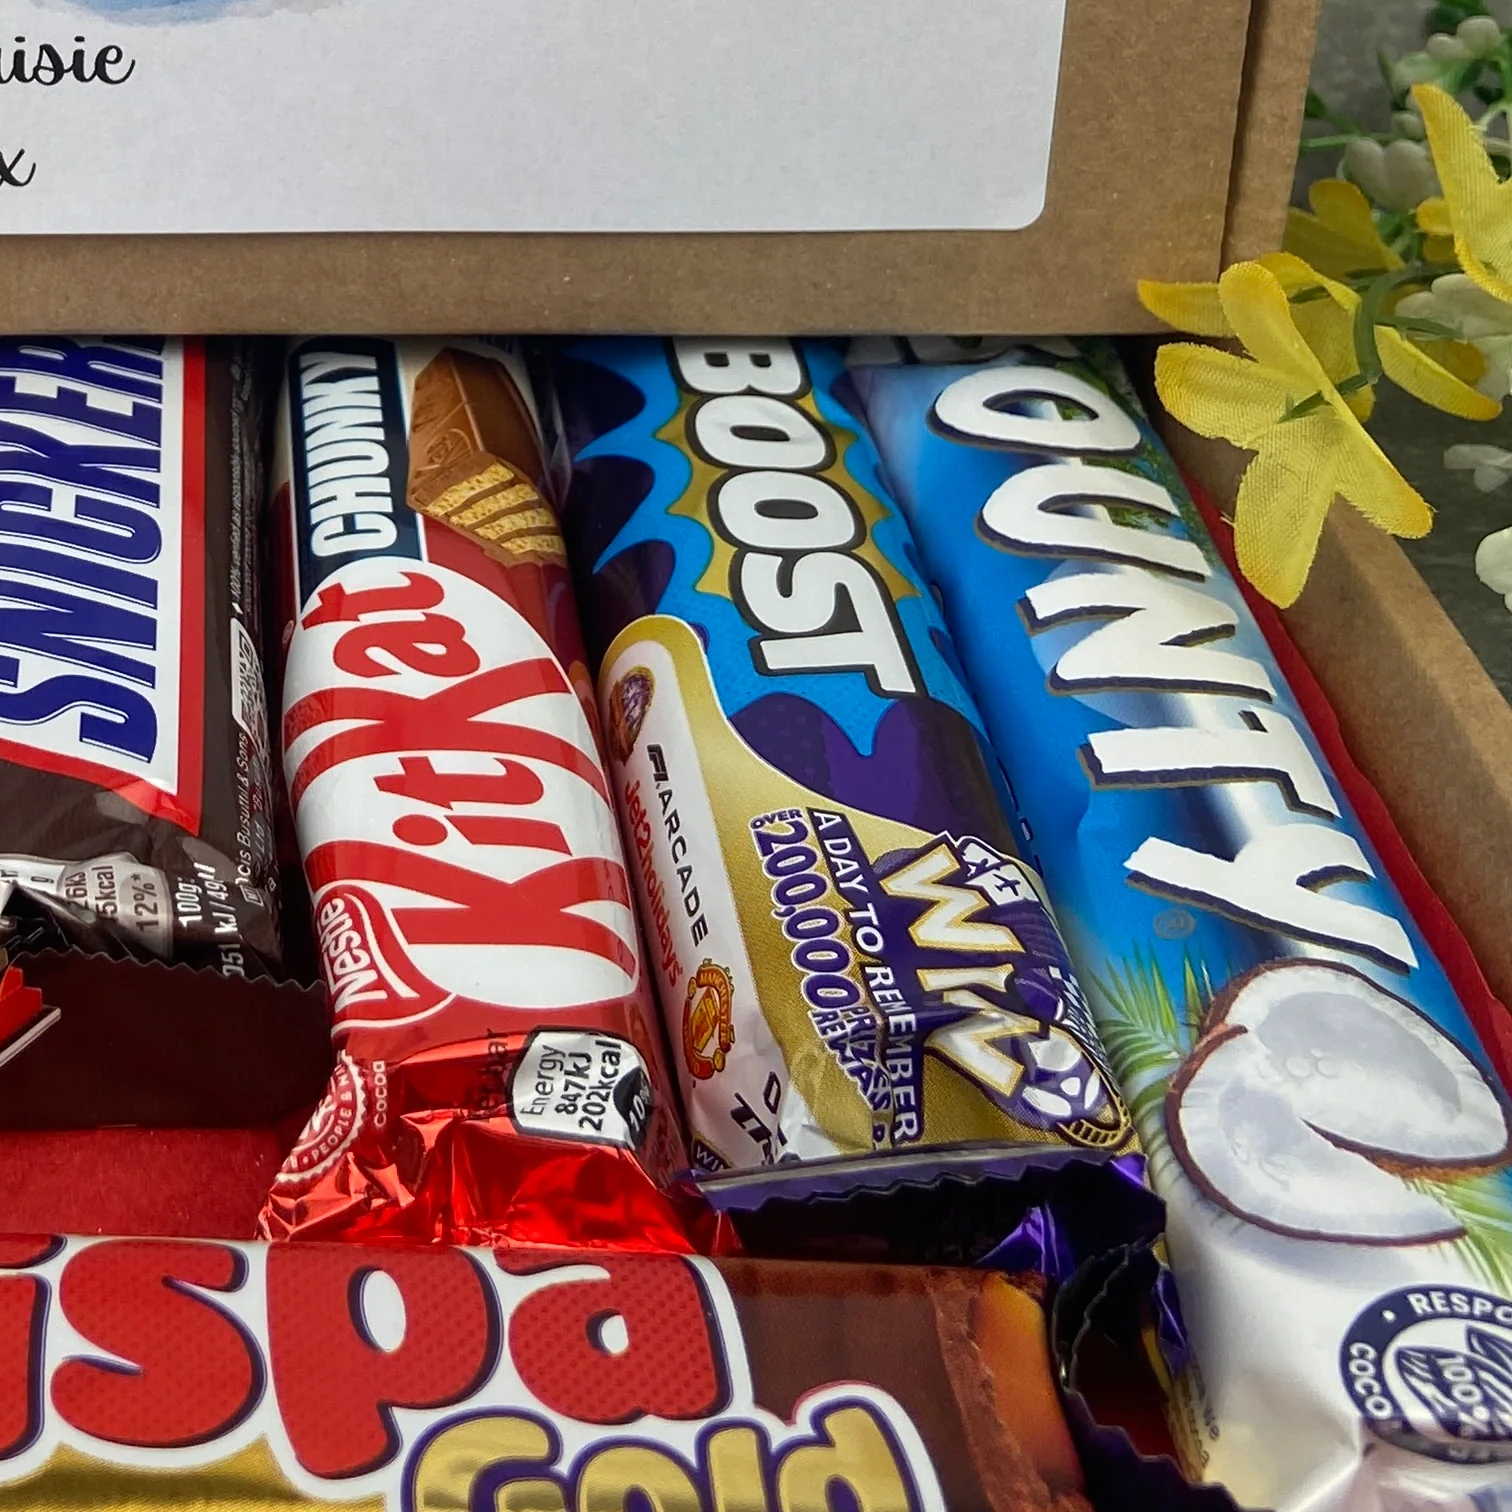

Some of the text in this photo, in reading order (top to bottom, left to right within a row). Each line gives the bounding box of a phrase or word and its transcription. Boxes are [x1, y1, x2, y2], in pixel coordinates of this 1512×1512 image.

[296, 350, 399, 556] CHUNKY
[672, 336, 920, 699] BOOST
[888, 336, 1418, 973] OUNTY
[657, 789, 710, 948] ARCADE
[751, 807, 804, 830] OVER
[752, 819, 862, 1010] 200,000
[814, 811, 920, 1143] A DAY TO REMEMBER
[879, 843, 1041, 1098] WIN
[311, 1106, 353, 1164] PEOPLE
[520, 1044, 567, 1115] Energy
[554, 1051, 593, 1115] 847kJ
[578, 1039, 623, 1133] 202kcal
